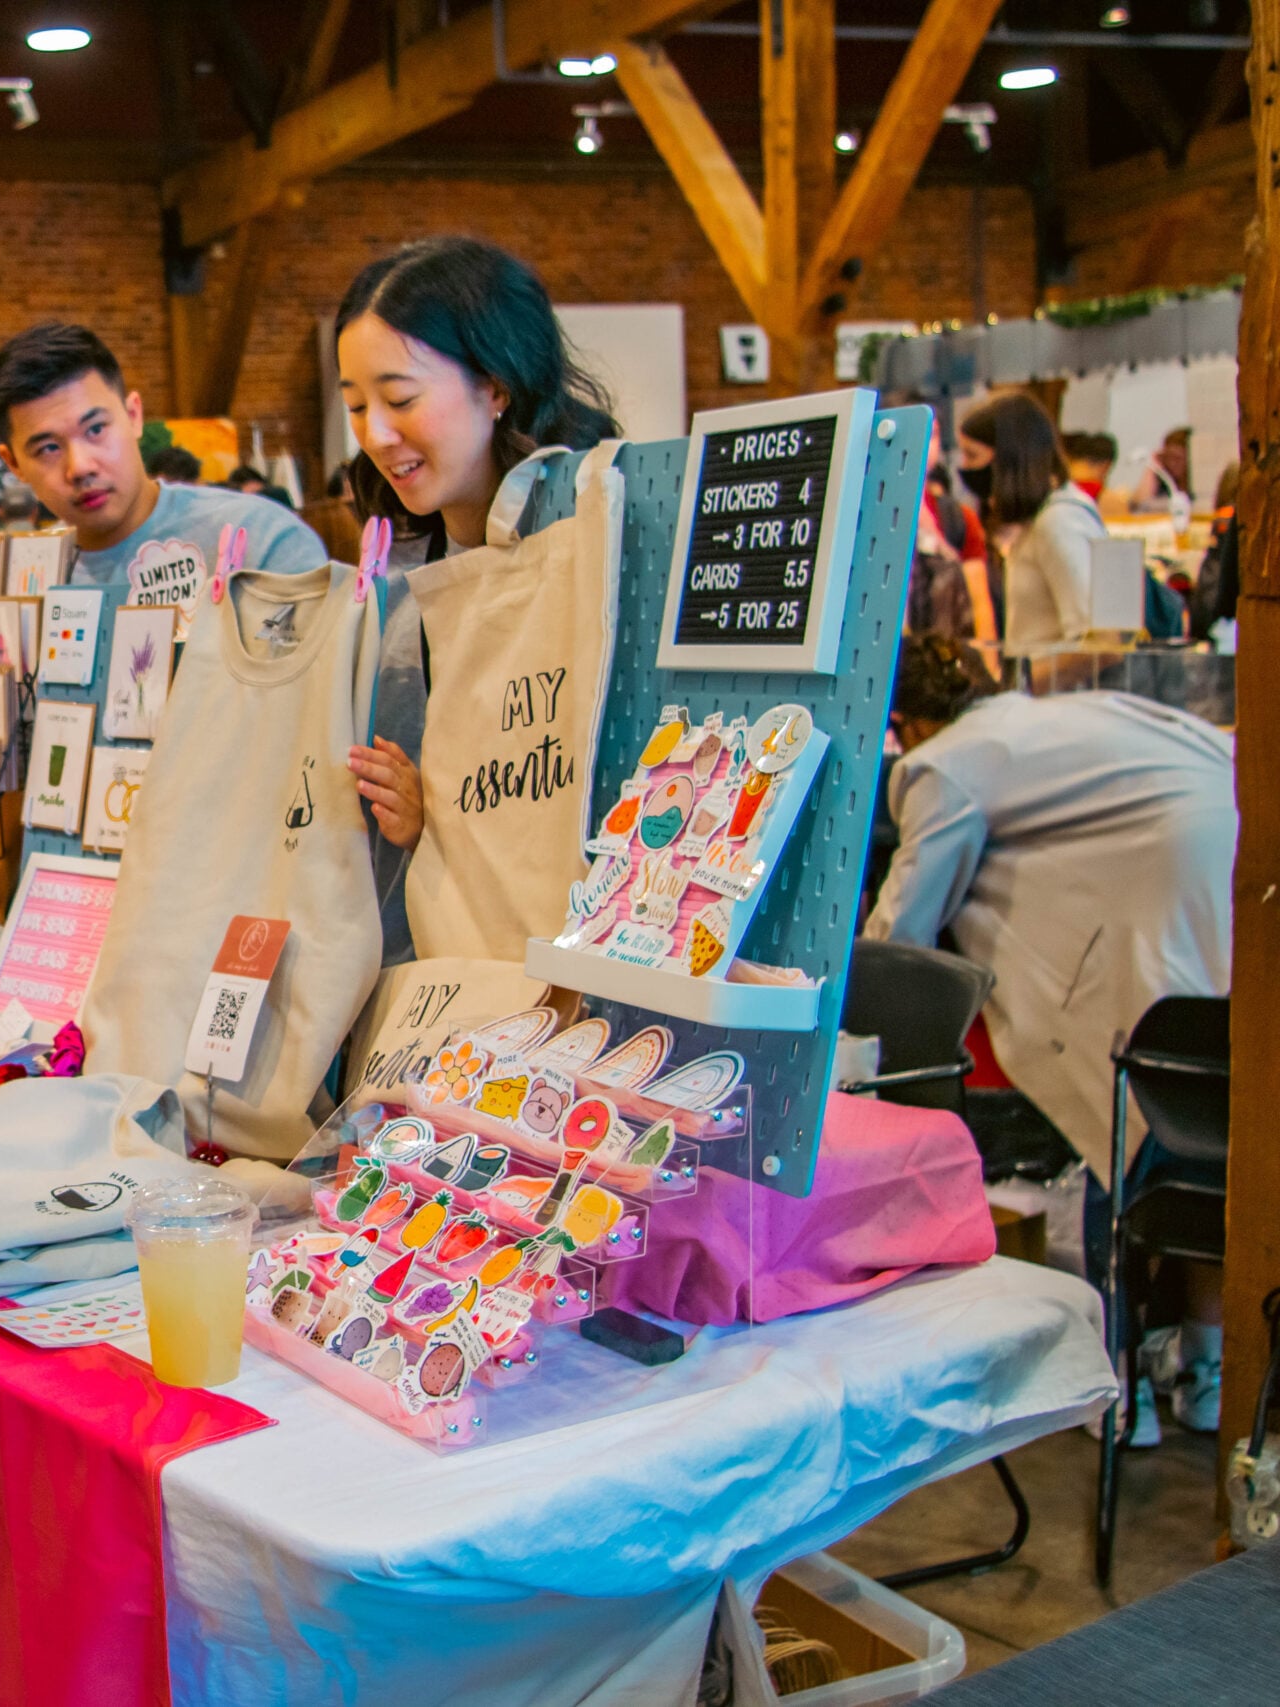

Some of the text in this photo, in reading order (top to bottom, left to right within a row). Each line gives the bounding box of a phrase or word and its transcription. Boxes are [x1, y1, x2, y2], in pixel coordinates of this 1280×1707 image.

[733, 430, 800, 463] PRICES
[702, 477, 811, 514] STICKERS 4
[733, 519, 810, 550] 3 FOR 10
[139, 557, 195, 588] LIMITED
[690, 560, 809, 591] CARDS 5.5
[138, 579, 196, 606] EDITION!
[718, 601, 799, 629] 5 FOR 25
[501, 667, 566, 732] MY
[453, 734, 574, 813] essenti
[691, 868, 749, 897] YOU'RE HUMAN
[630, 933, 665, 954] KIND
[397, 983, 461, 1029] MY
[497, 1054, 517, 1065] MORE
[109, 1171, 138, 1189] HAVE
